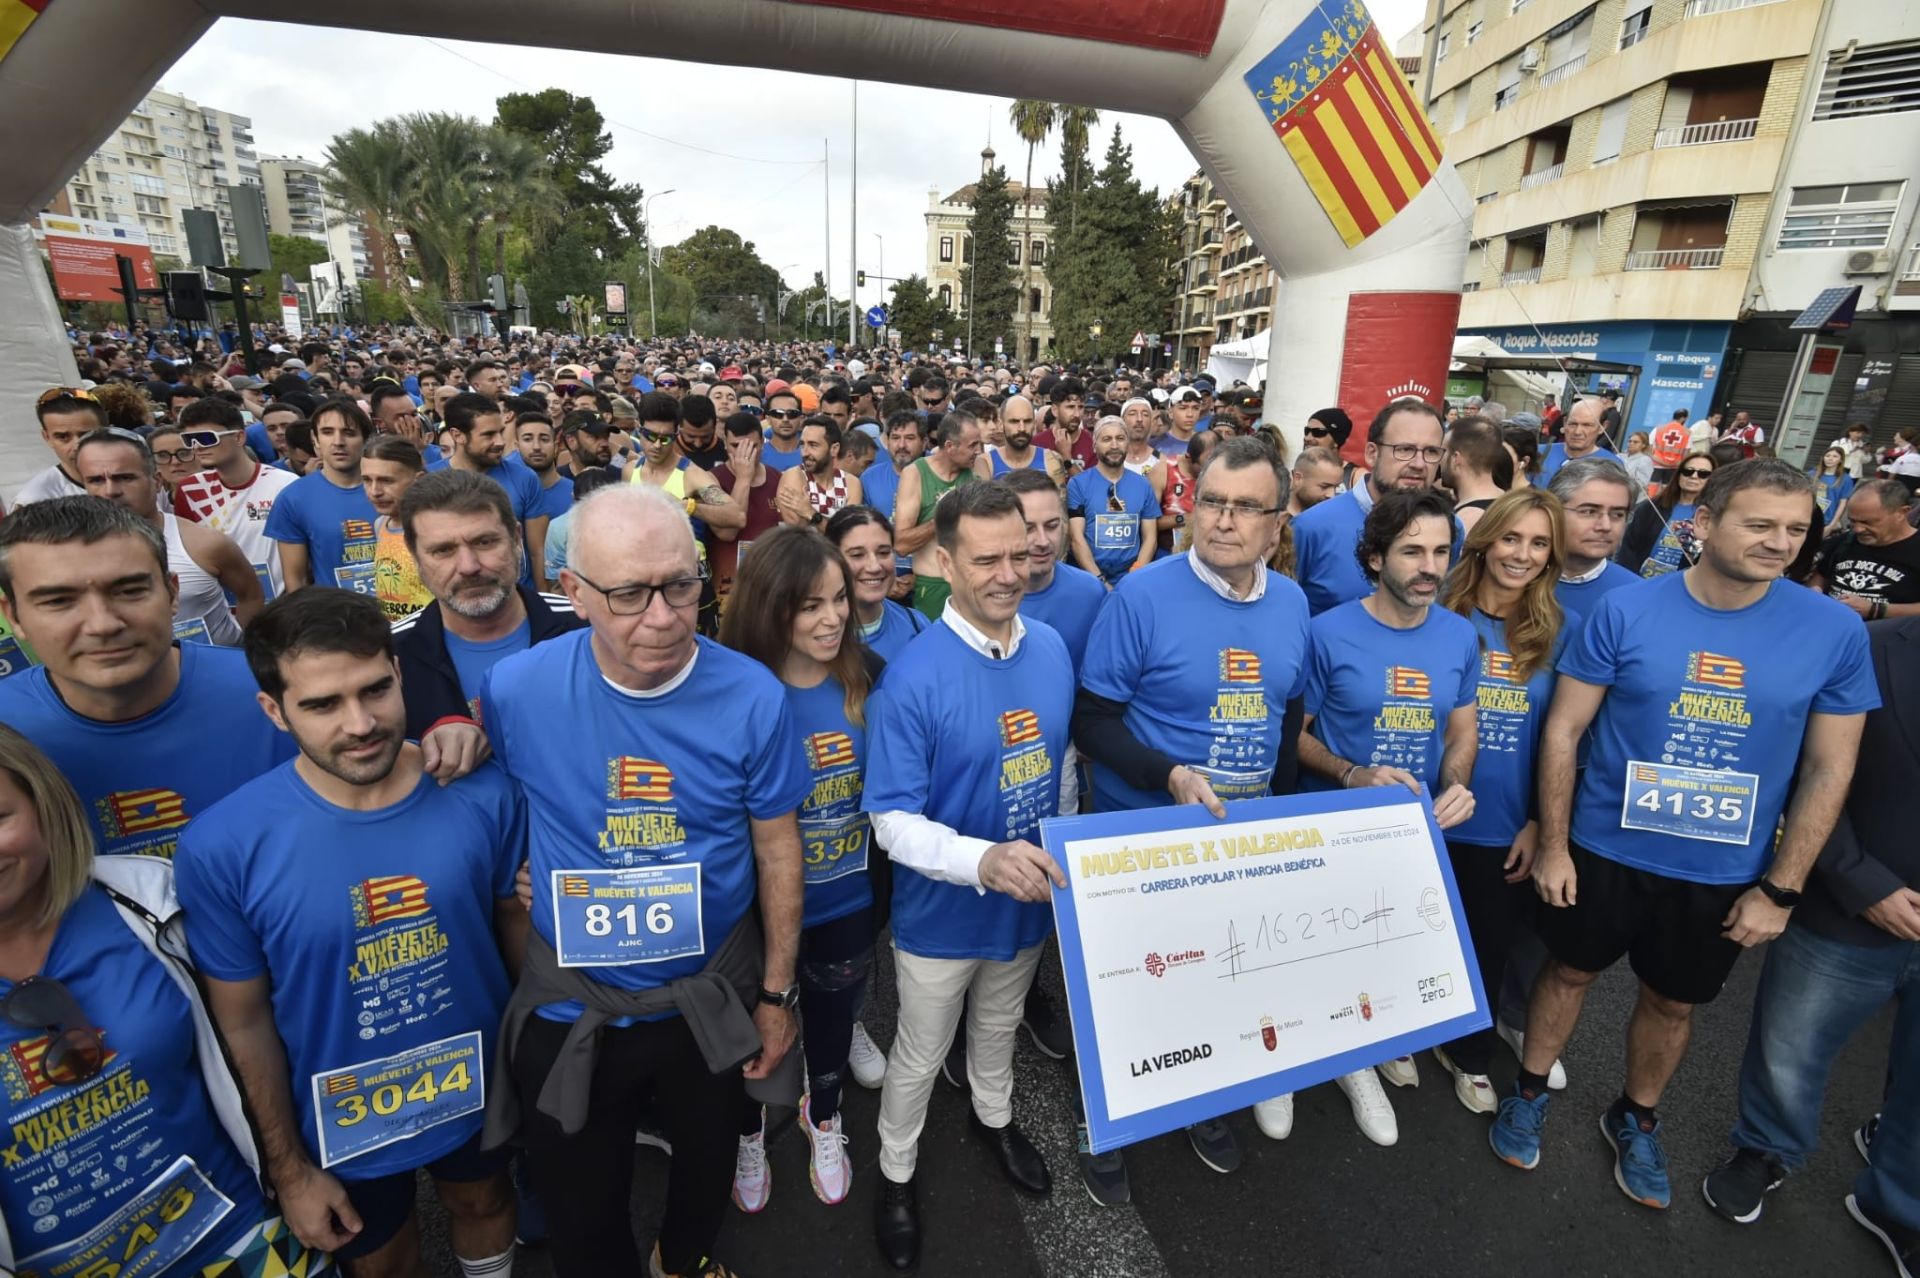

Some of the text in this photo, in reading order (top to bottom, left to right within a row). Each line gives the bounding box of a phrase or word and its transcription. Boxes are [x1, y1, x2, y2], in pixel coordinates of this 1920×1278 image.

[1504, 332, 1538, 352] Roque
[1540, 330, 1599, 348] Mascotas
[1655, 354, 1711, 365] San Roque
[1651, 379, 1704, 390] Mascotas
[1104, 525, 1132, 538] 450
[1854, 560, 1878, 572] ROCK
[1883, 568, 1906, 582] ROLL
[1217, 691, 1264, 707] MUÉVETE
[1680, 692, 1746, 712] MUÉVETE
[1209, 705, 1268, 719] X VALENCIA
[1668, 702, 1680, 716] X
[1683, 704, 1751, 726] VALENCIA
[1374, 716, 1435, 730] X VALENCIA
[1709, 784, 1750, 796] VALENCIA
[1636, 789, 1743, 822] 4135
[606, 812, 677, 832] MUÉVETE
[598, 831, 610, 849] X
[613, 826, 686, 846] VALENCIA
[804, 830, 862, 864] 330
[1331, 839, 1342, 847] 24
[1342, 837, 1352, 845] DE
[1352, 832, 1392, 844] NOVIEMBRE
[1404, 828, 1420, 837] 2024
[1080, 828, 1324, 878] MUÉVETE X VALENCIA
[1140, 857, 1326, 894] CARRERA POPULAR Y MARCHA BENÉFICA
[594, 882, 694, 899] MUÉVETE X VALENCIA
[1087, 892, 1101, 900] CON
[1102, 888, 1126, 897] MOTIVO
[584, 902, 674, 937] 816
[357, 922, 438, 962] MUÉVETE
[617, 938, 643, 947] AJNC
[348, 934, 449, 982] X VALENCIA
[1166, 949, 1205, 963] Cáritas
[1107, 967, 1134, 978] ENTREGA
[1418, 976, 1436, 992] pre
[363, 996, 381, 1009] MG
[1420, 988, 1446, 1004] zero
[1276, 1023, 1284, 1031] de
[1284, 1018, 1303, 1030] Murcia
[363, 1046, 474, 1087] MUÉVETE X VALENCIA
[1130, 1044, 1213, 1077] LA VERDAD
[8, 1105, 40, 1125] CARRERA
[40, 1091, 72, 1109] POPULAR
[78, 1076, 104, 1092] MARCHA
[335, 1060, 473, 1127] 3044
[12, 1070, 133, 1142] MUÉVETE
[2, 1142, 24, 1168] X
[28, 1079, 150, 1153] VALENCIA
[112, 1108, 154, 1134] LA VERDAD
[15, 1154, 42, 1170] FAVOR
[54, 1140, 69, 1151] LOS
[69, 1119, 108, 1142] AFECTADOS
[108, 1112, 122, 1122] POR
[122, 1105, 133, 1114] LA
[133, 1096, 149, 1109] DANA
[32, 1175, 60, 1196] MG
[50, 1223, 130, 1276] MUÉVETE X
